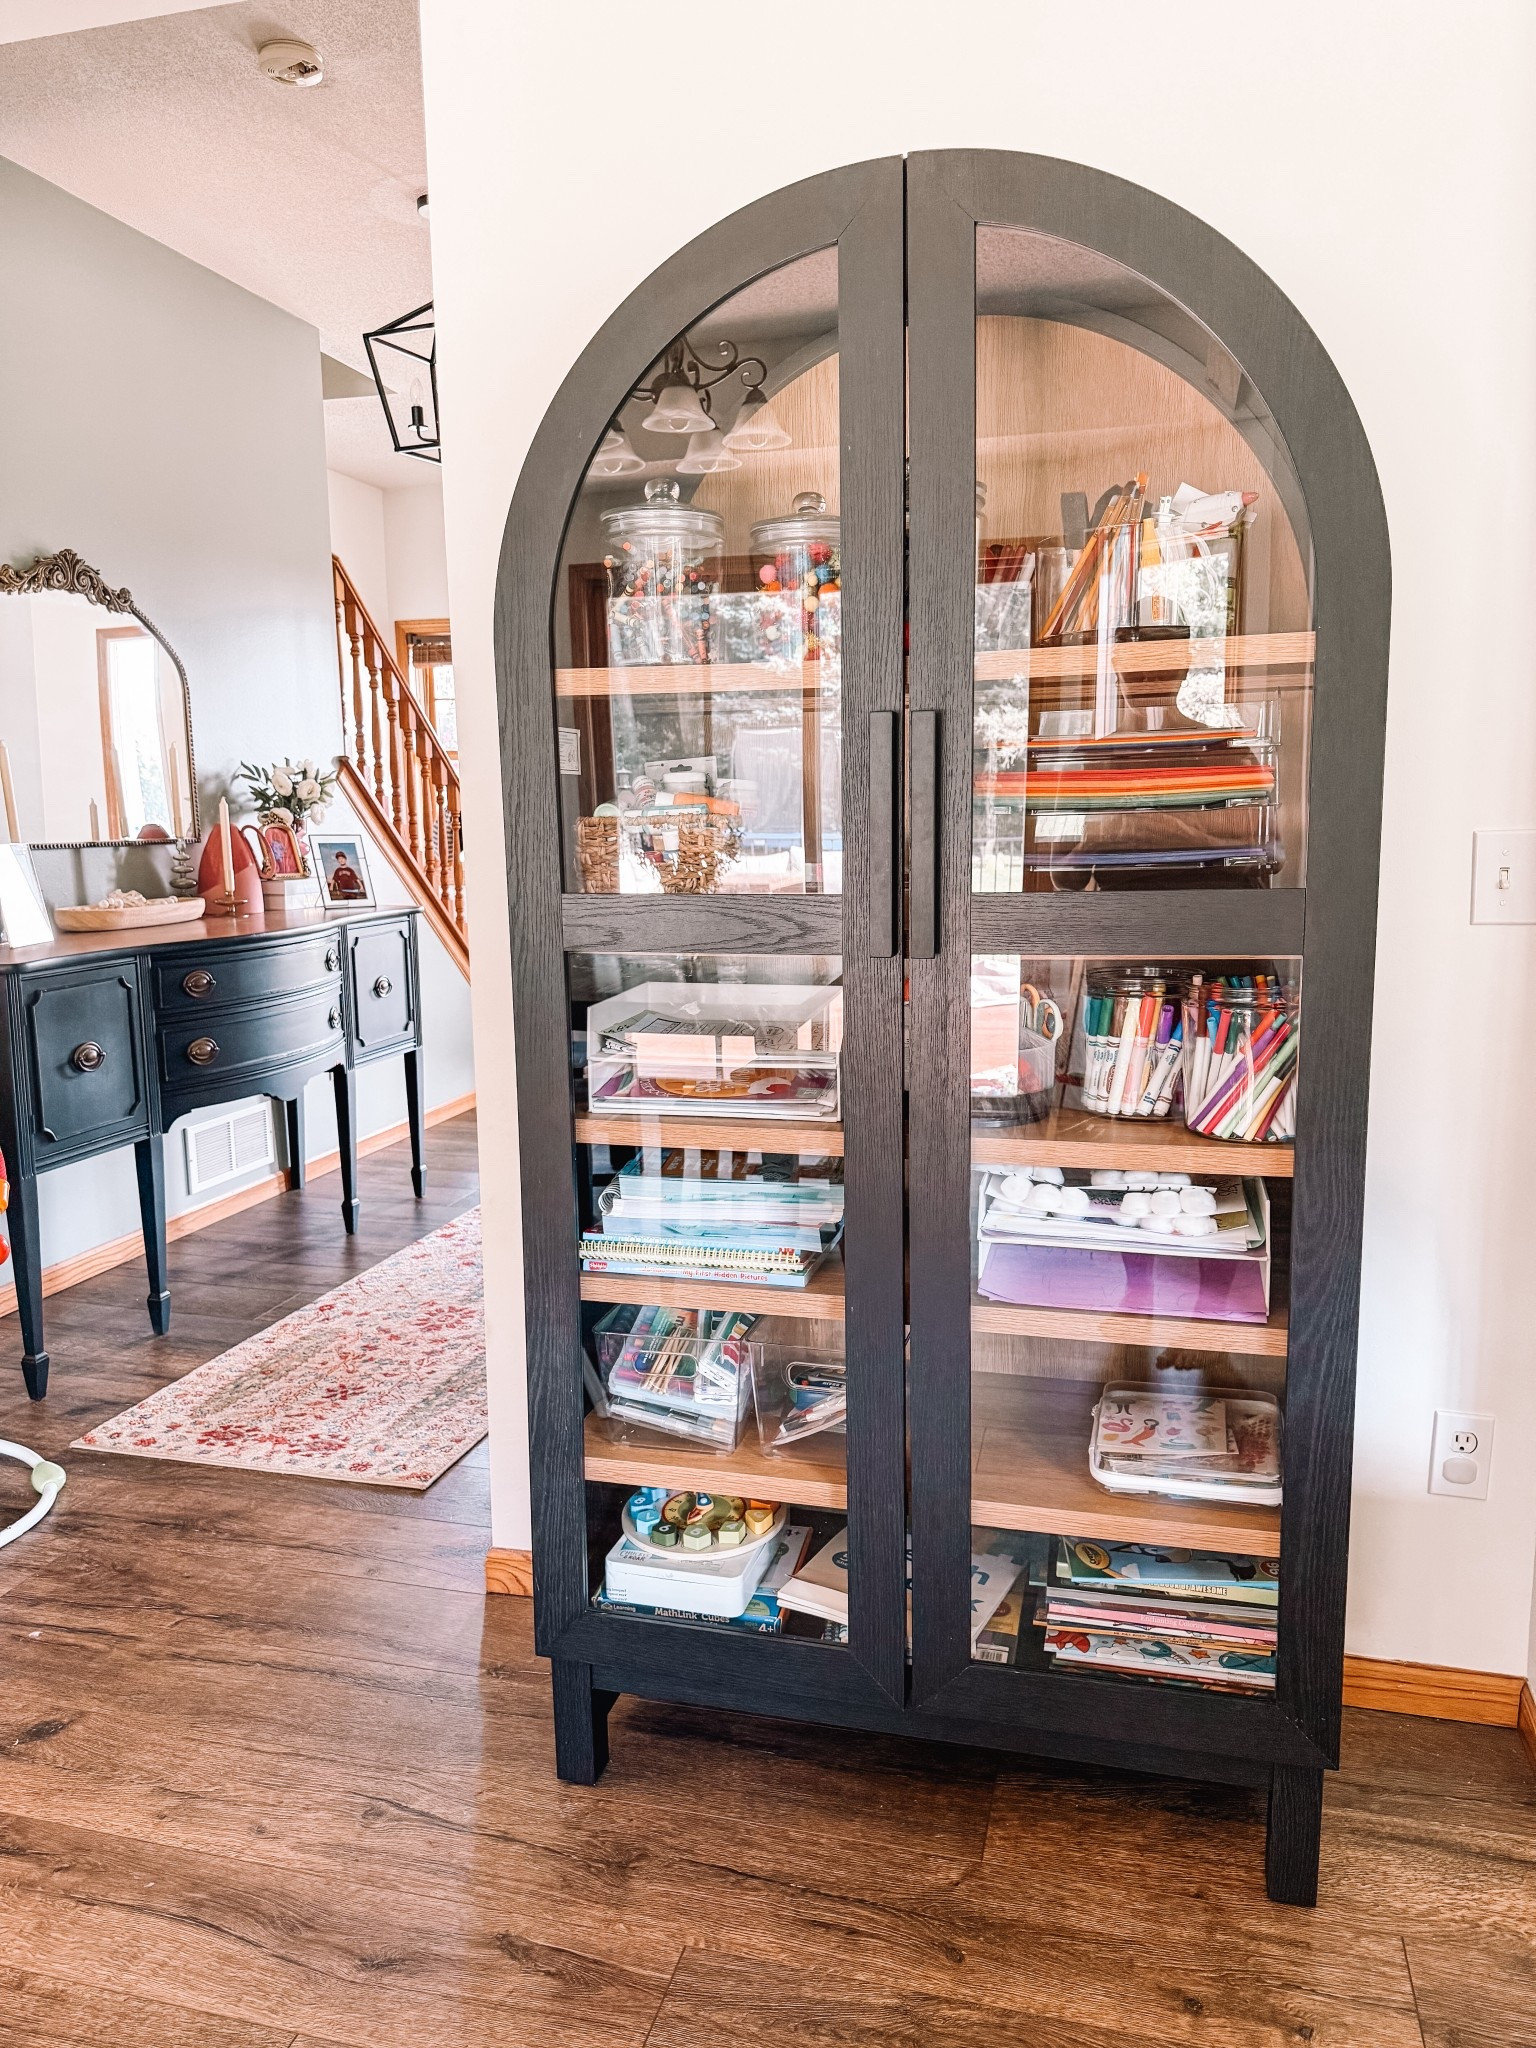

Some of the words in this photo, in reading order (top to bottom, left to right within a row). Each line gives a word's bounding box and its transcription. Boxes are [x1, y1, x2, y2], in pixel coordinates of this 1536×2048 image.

[682, 1270, 693, 1278] My
[695, 1269, 711, 1277] First
[714, 1271, 738, 1279] Hidden
[740, 1273, 768, 1282] Pictures
[659, 1524, 672, 1532] 6
[726, 1522, 740, 1530] 4
[1190, 1585, 1228, 1596] AWESOME
[613, 1604, 636, 1613] Learning
[654, 1608, 698, 1620] MathLink
[701, 1613, 730, 1623] Cubes
[1140, 1615, 1178, 1626] Enchanting
[1178, 1619, 1207, 1630] Coloring
[758, 1624, 774, 1633] 4+
